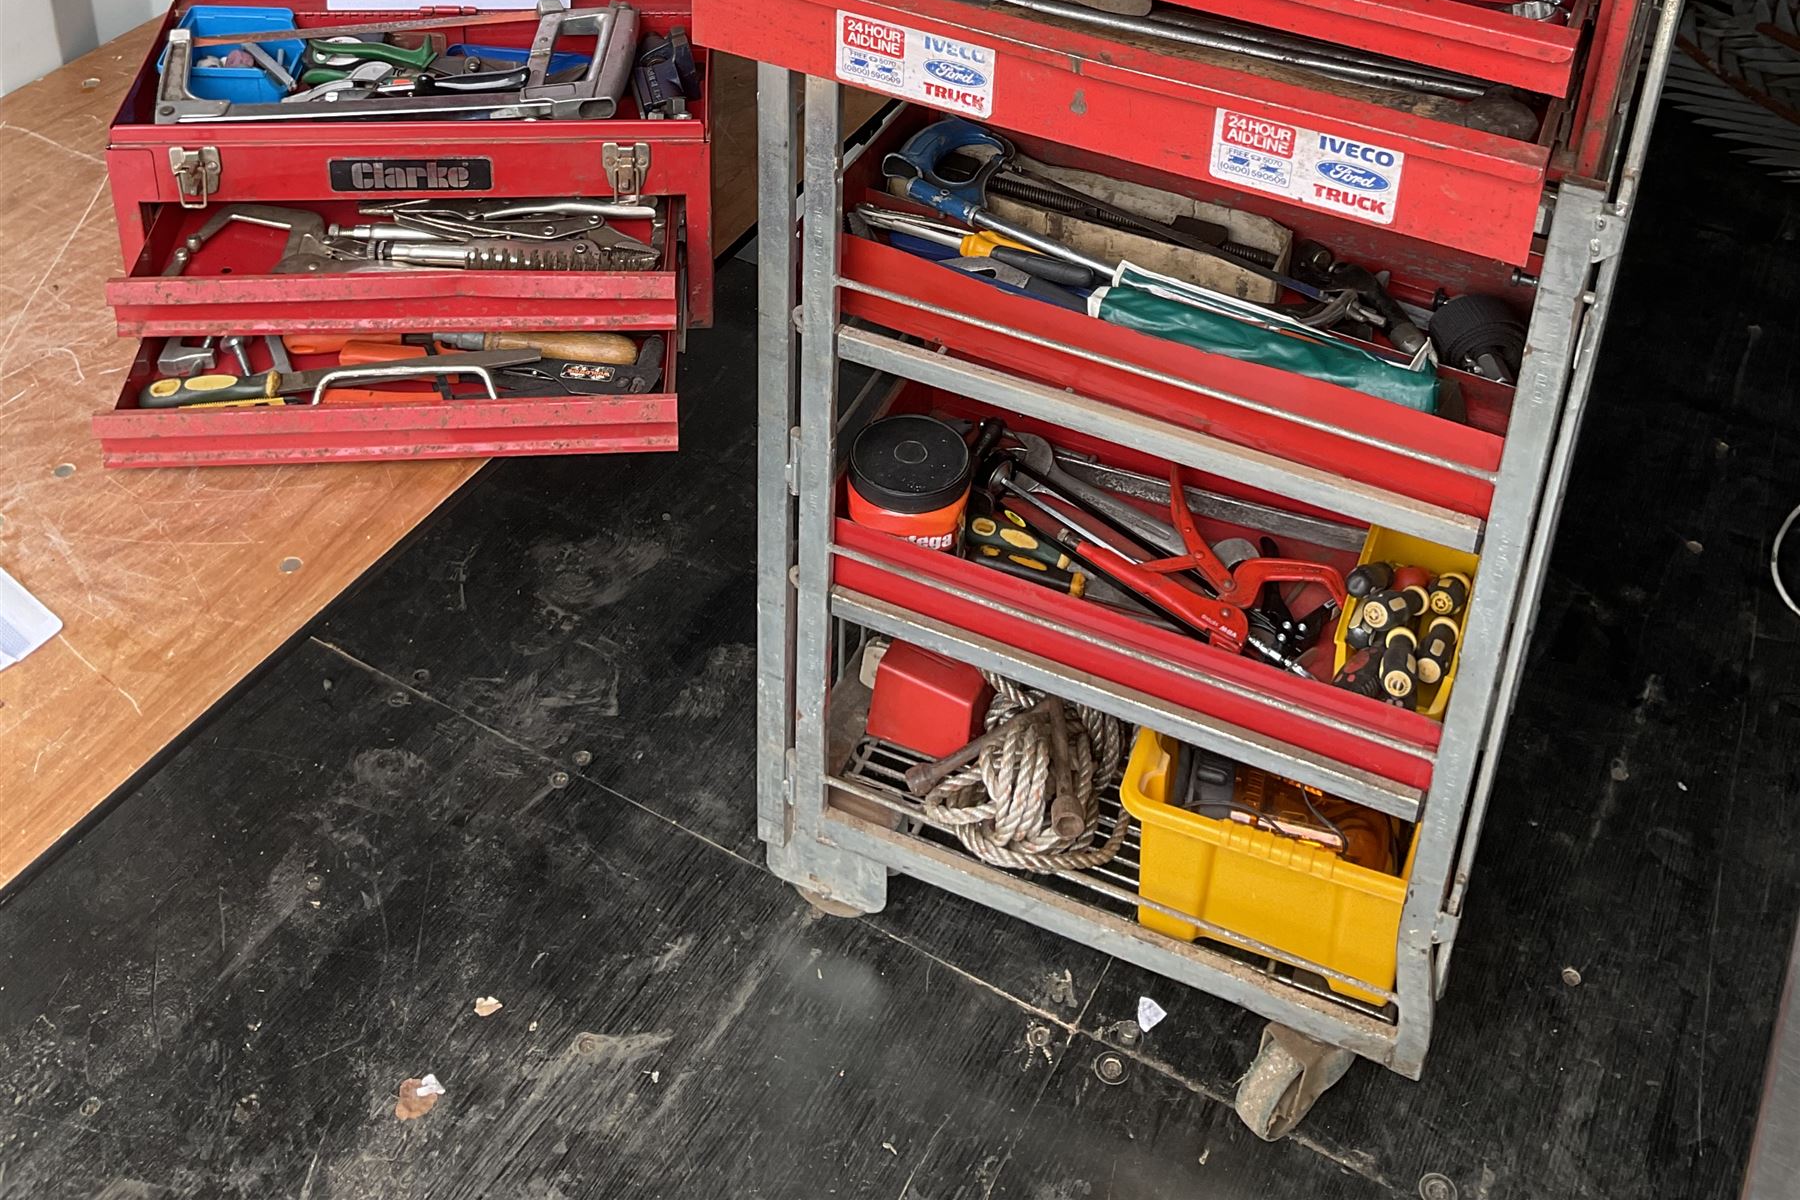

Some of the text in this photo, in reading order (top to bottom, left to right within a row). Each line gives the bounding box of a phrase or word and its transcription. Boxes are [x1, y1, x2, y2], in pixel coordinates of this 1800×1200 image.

[848, 20, 901, 43] 24 HOUR
[848, 32, 900, 55] AIDLINE
[878, 57, 897, 67] 5070
[924, 36, 985, 64] IVECO
[844, 63, 870, 76] (0800)
[936, 62, 975, 85] Ford
[923, 82, 985, 112] TRUCK
[1228, 115, 1292, 141] 24 HOUR
[1227, 128, 1290, 155] AIDLINE
[1319, 135, 1395, 167] IVECO
[1228, 147, 1283, 167] FREE 5070
[351, 162, 469, 189] Clarke
[1220, 161, 1287, 185] (0800) 590509
[1330, 163, 1375, 188] Ford
[1313, 183, 1387, 215] TRUCK
